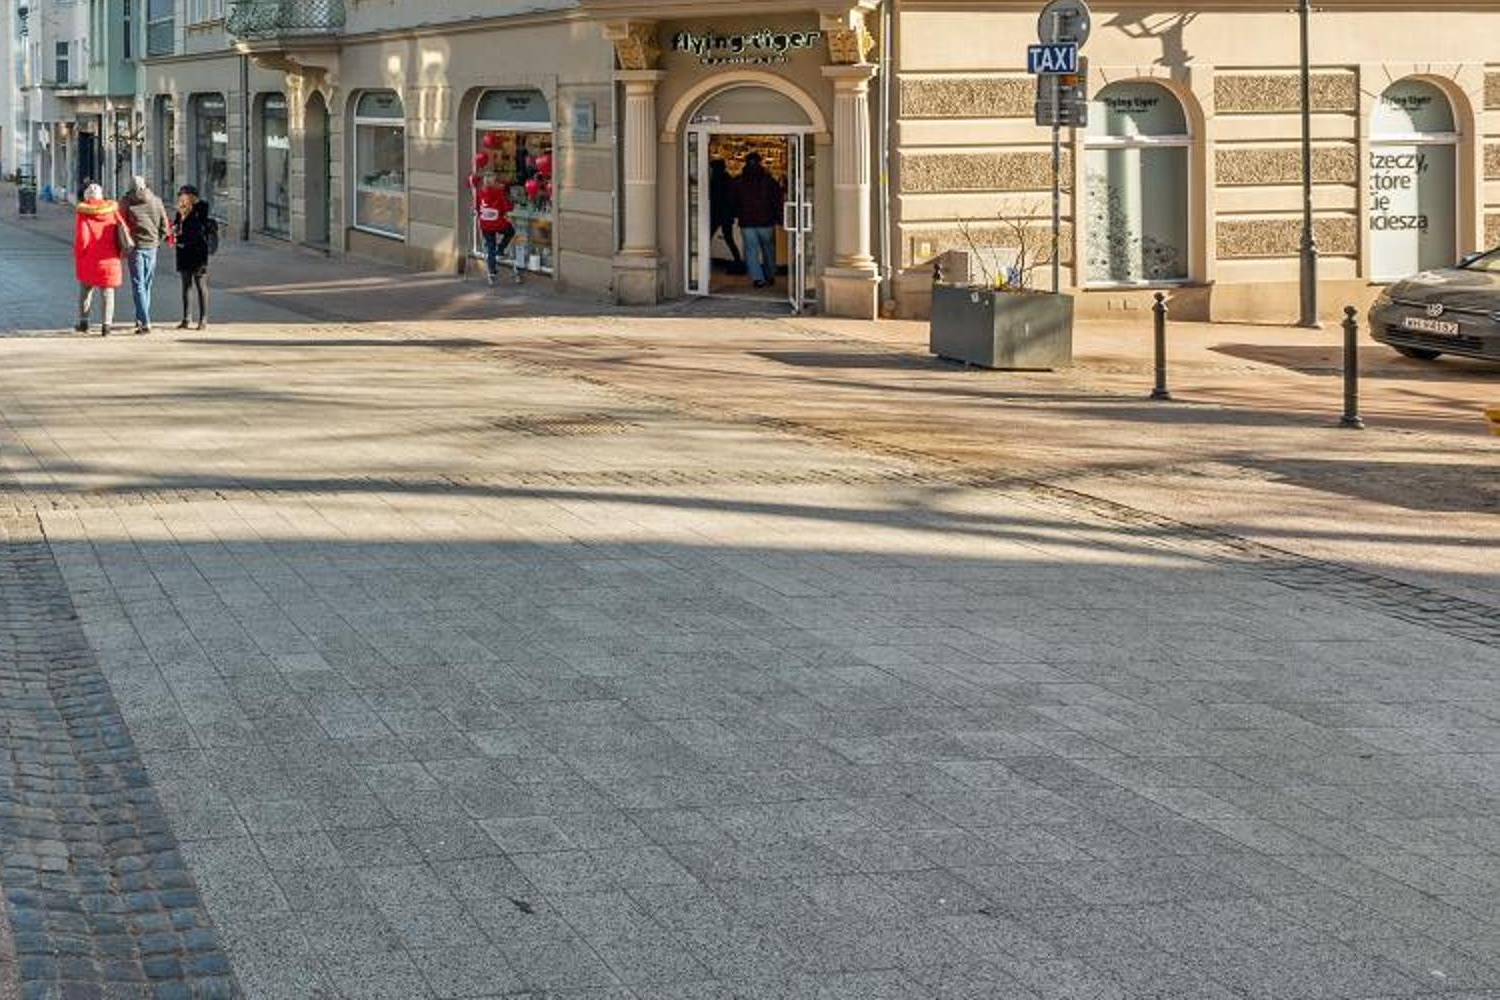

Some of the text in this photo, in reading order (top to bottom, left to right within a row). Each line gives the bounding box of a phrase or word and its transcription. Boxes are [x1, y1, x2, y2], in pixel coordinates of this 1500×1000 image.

[672, 29, 821, 57] flying tiger
[1029, 46, 1075, 72] TAXI
